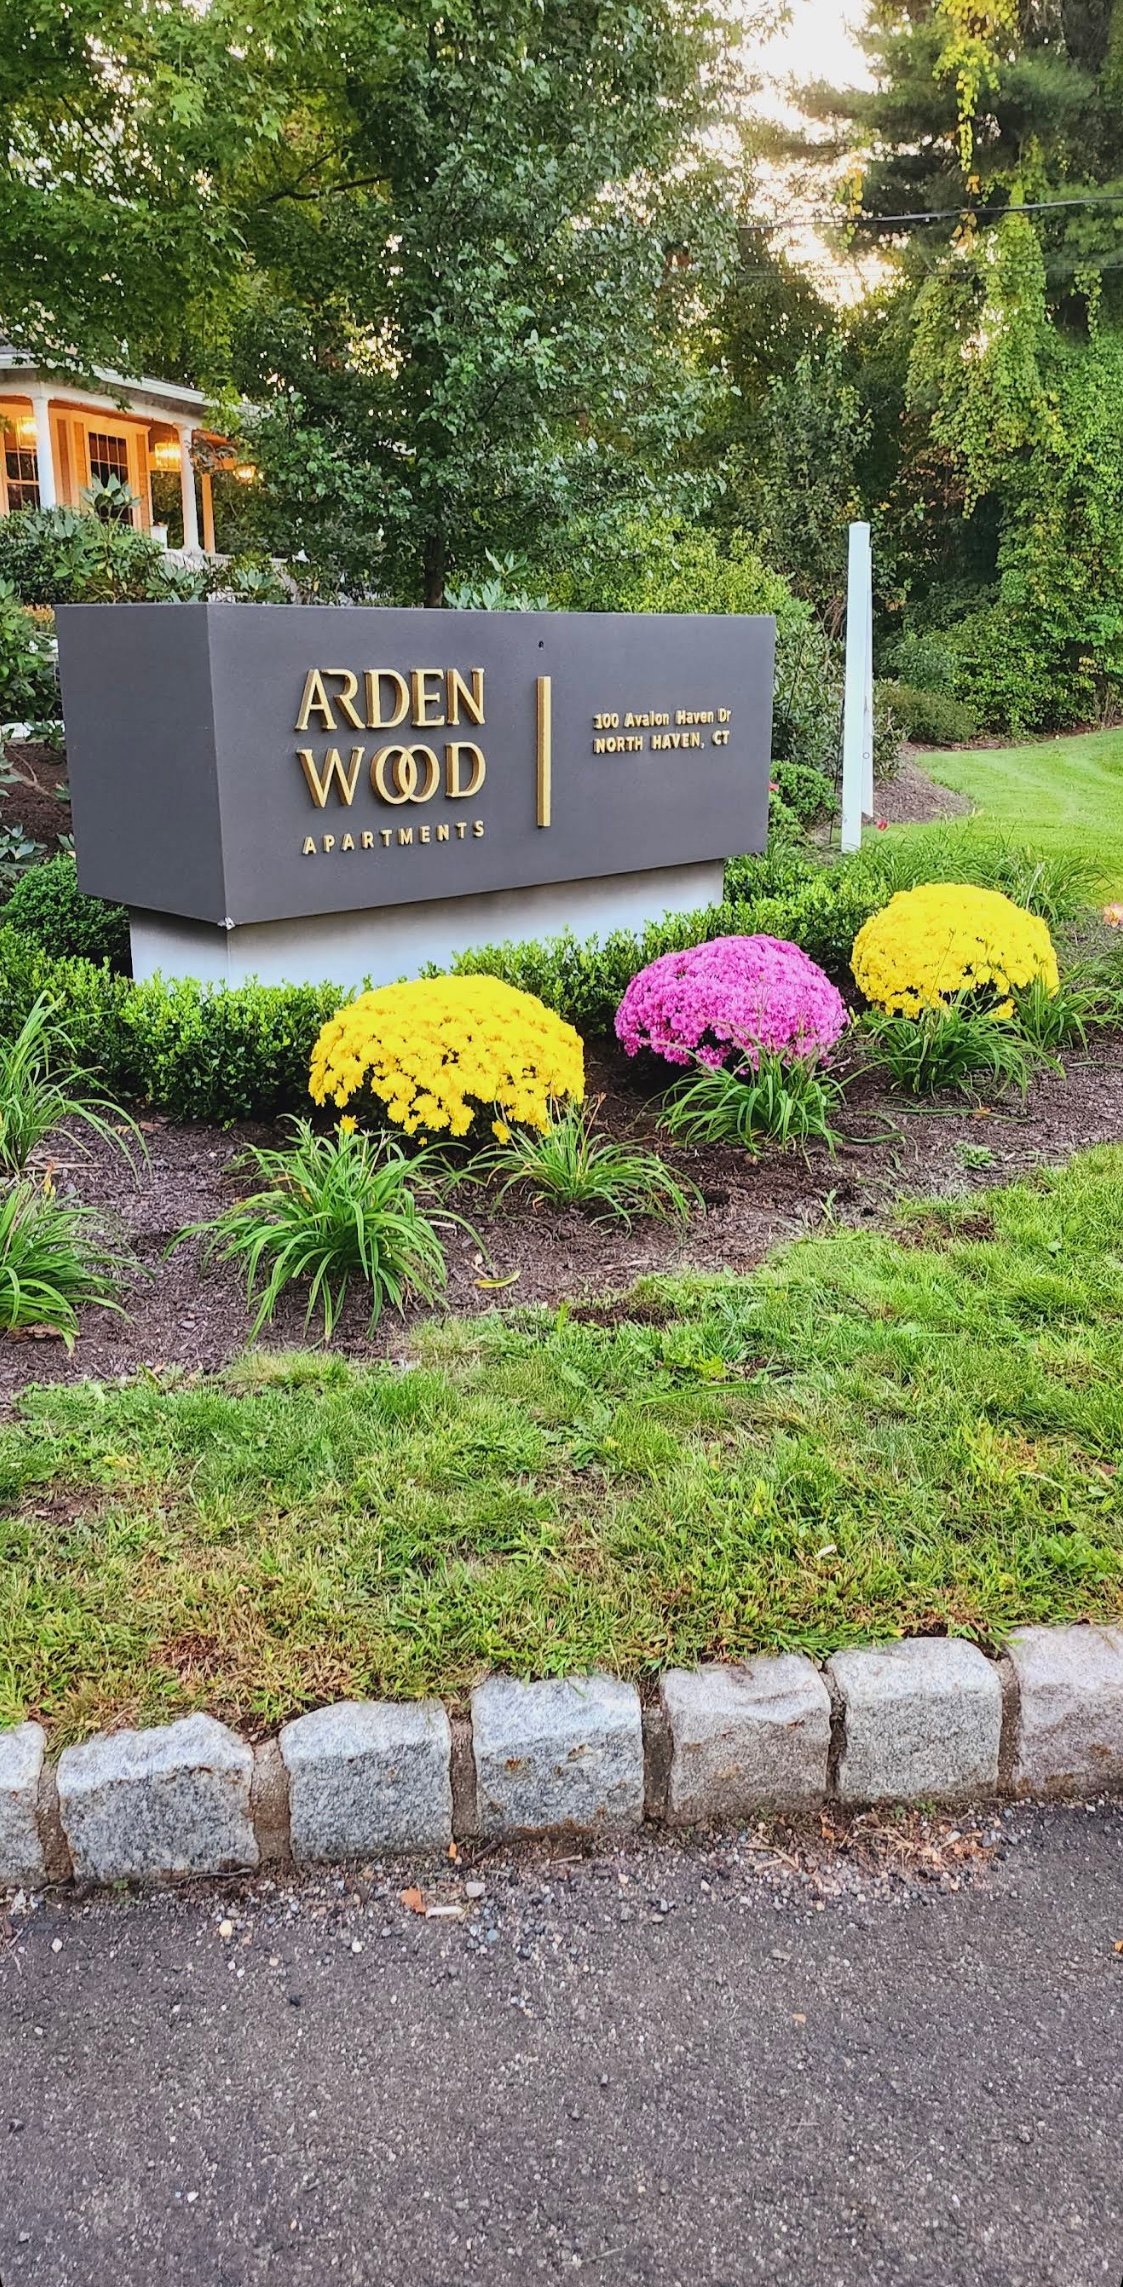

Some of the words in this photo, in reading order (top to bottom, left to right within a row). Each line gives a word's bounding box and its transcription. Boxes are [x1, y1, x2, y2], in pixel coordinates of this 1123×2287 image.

[294, 668, 486, 731] ARDEN
[593, 712, 620, 730] 100
[624, 710, 670, 728] Avalon
[675, 709, 714, 726] Haven
[718, 707, 732, 723] Dr
[593, 736, 644, 754] NORTH
[652, 732, 705, 750] HAVEN,
[712, 730, 730, 746] CT
[295, 741, 487, 808] WOOD
[302, 819, 486, 856] APARTMENTS
